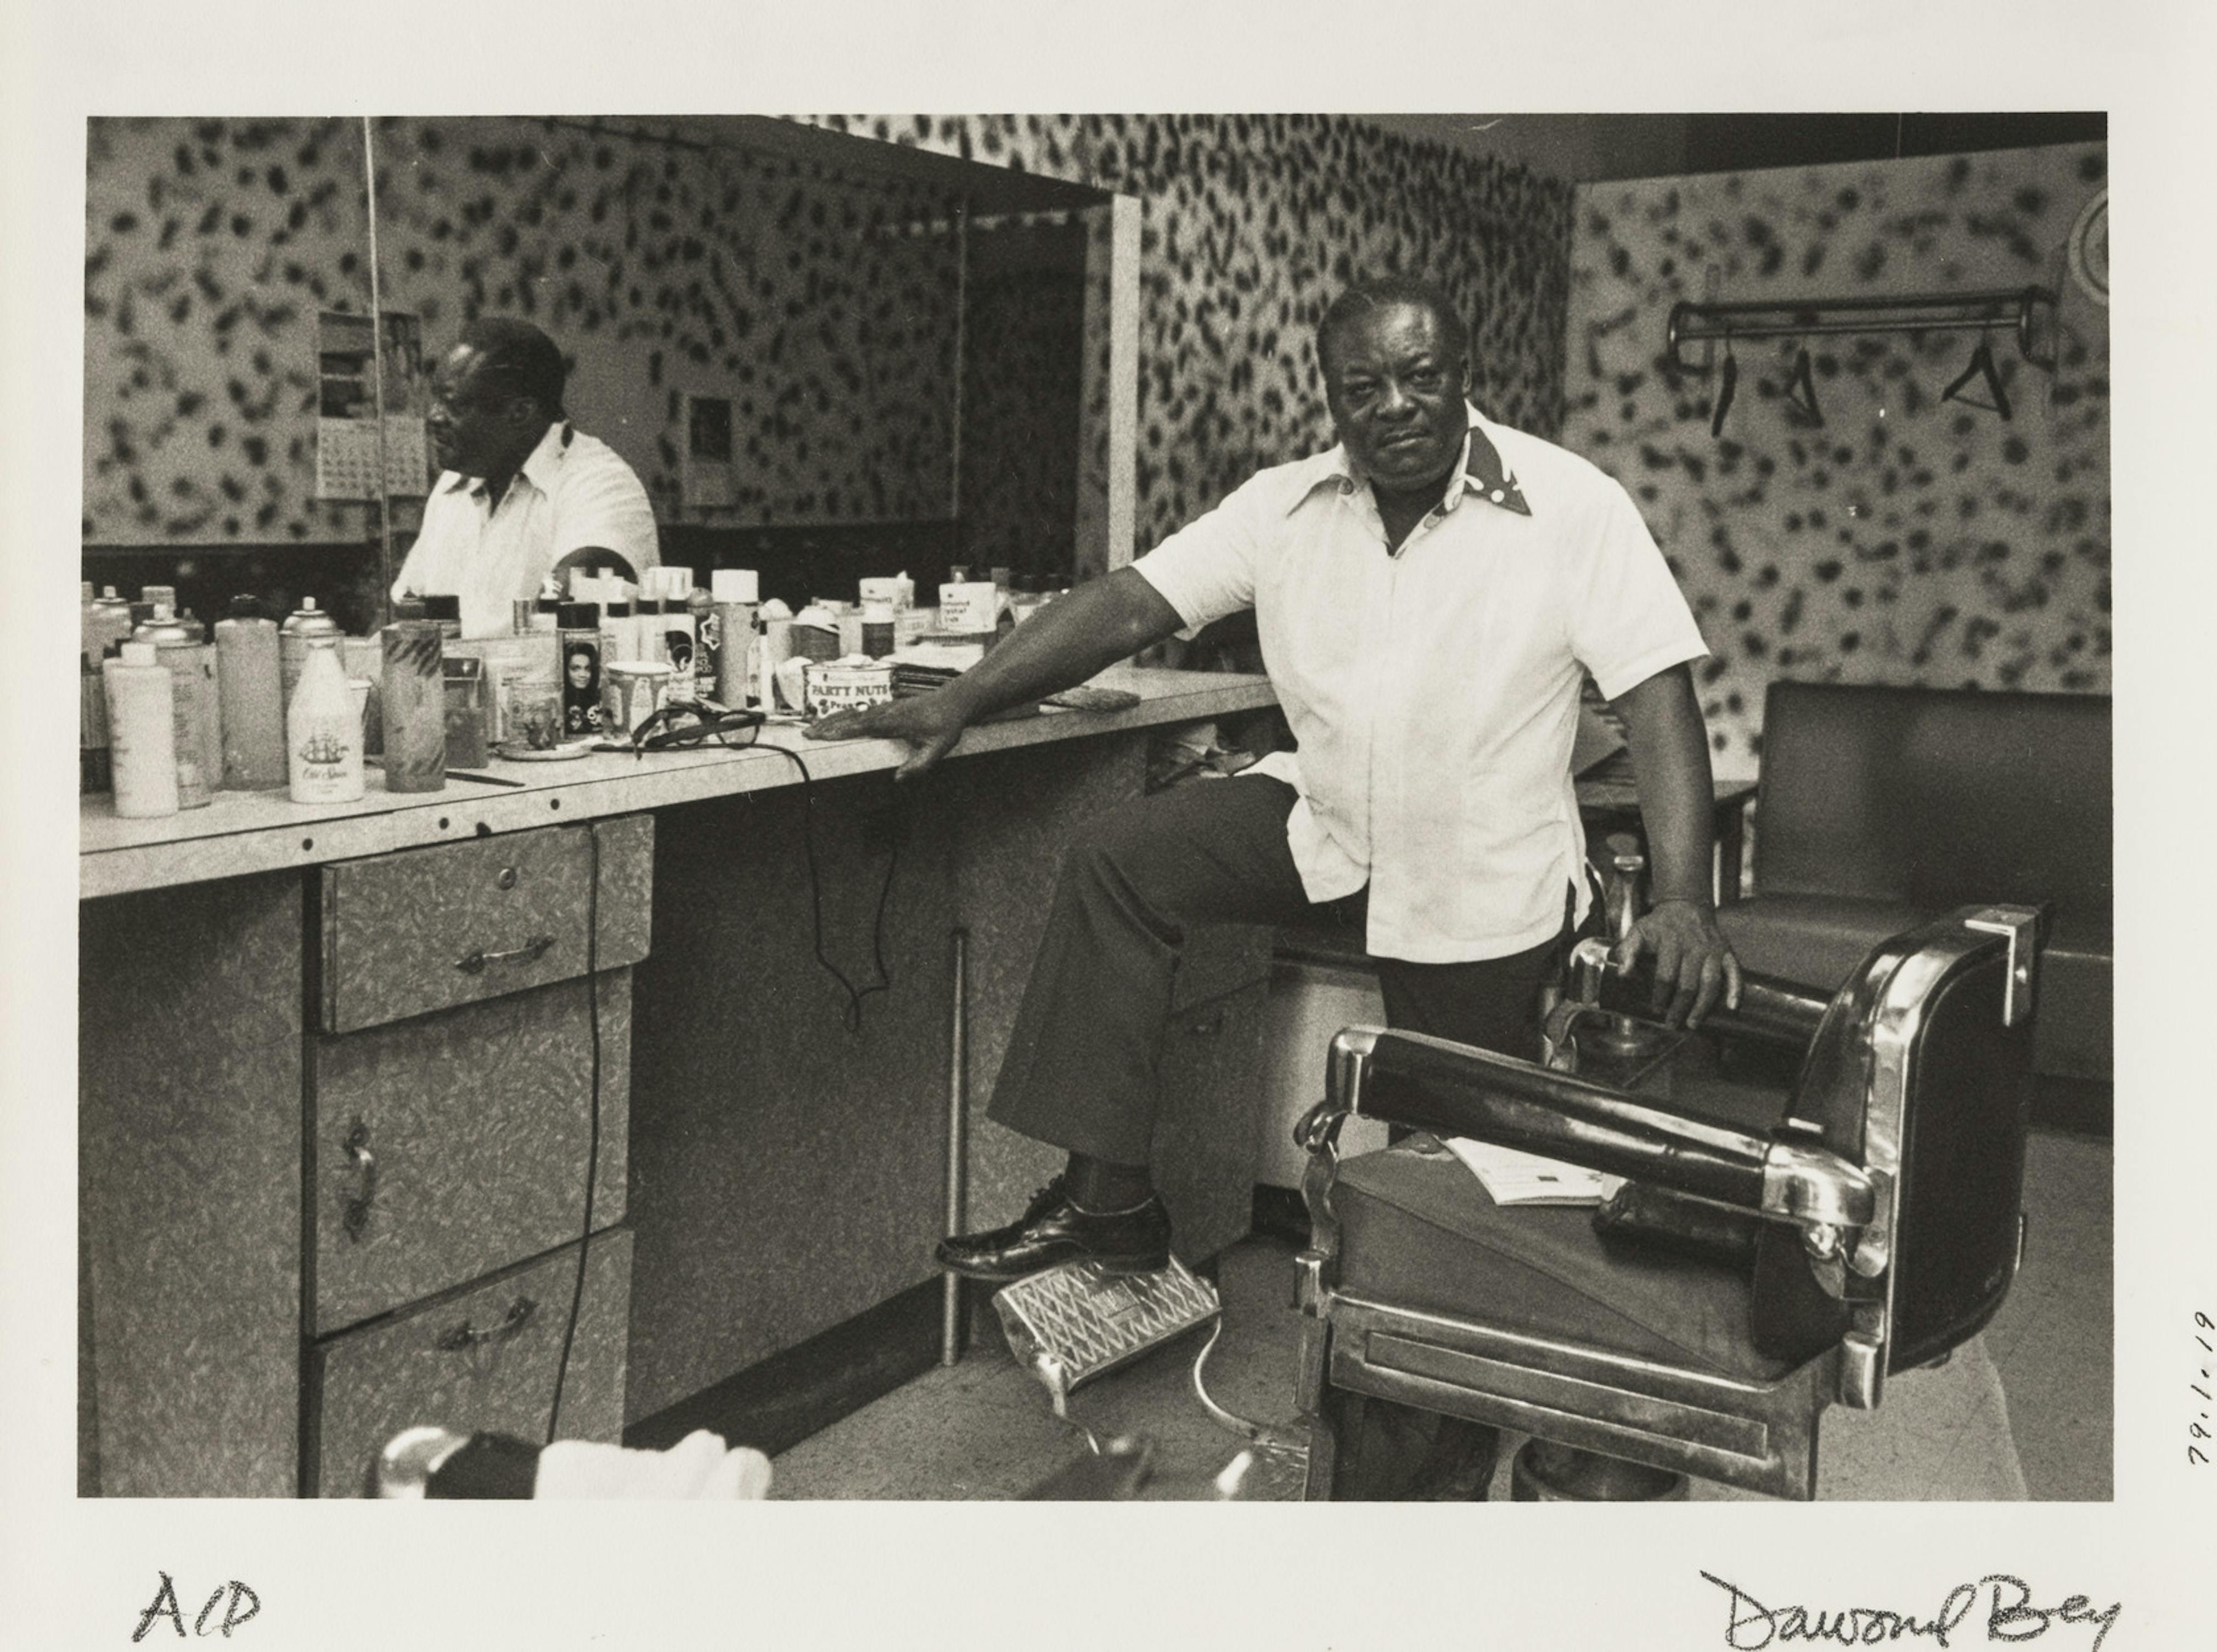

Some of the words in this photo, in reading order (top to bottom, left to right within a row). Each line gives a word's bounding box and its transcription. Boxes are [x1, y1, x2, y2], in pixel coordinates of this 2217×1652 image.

[812, 685, 851, 696] PARTY
[856, 684, 888, 696] NUTS
[1979, 1574, 2122, 1652] Bey
